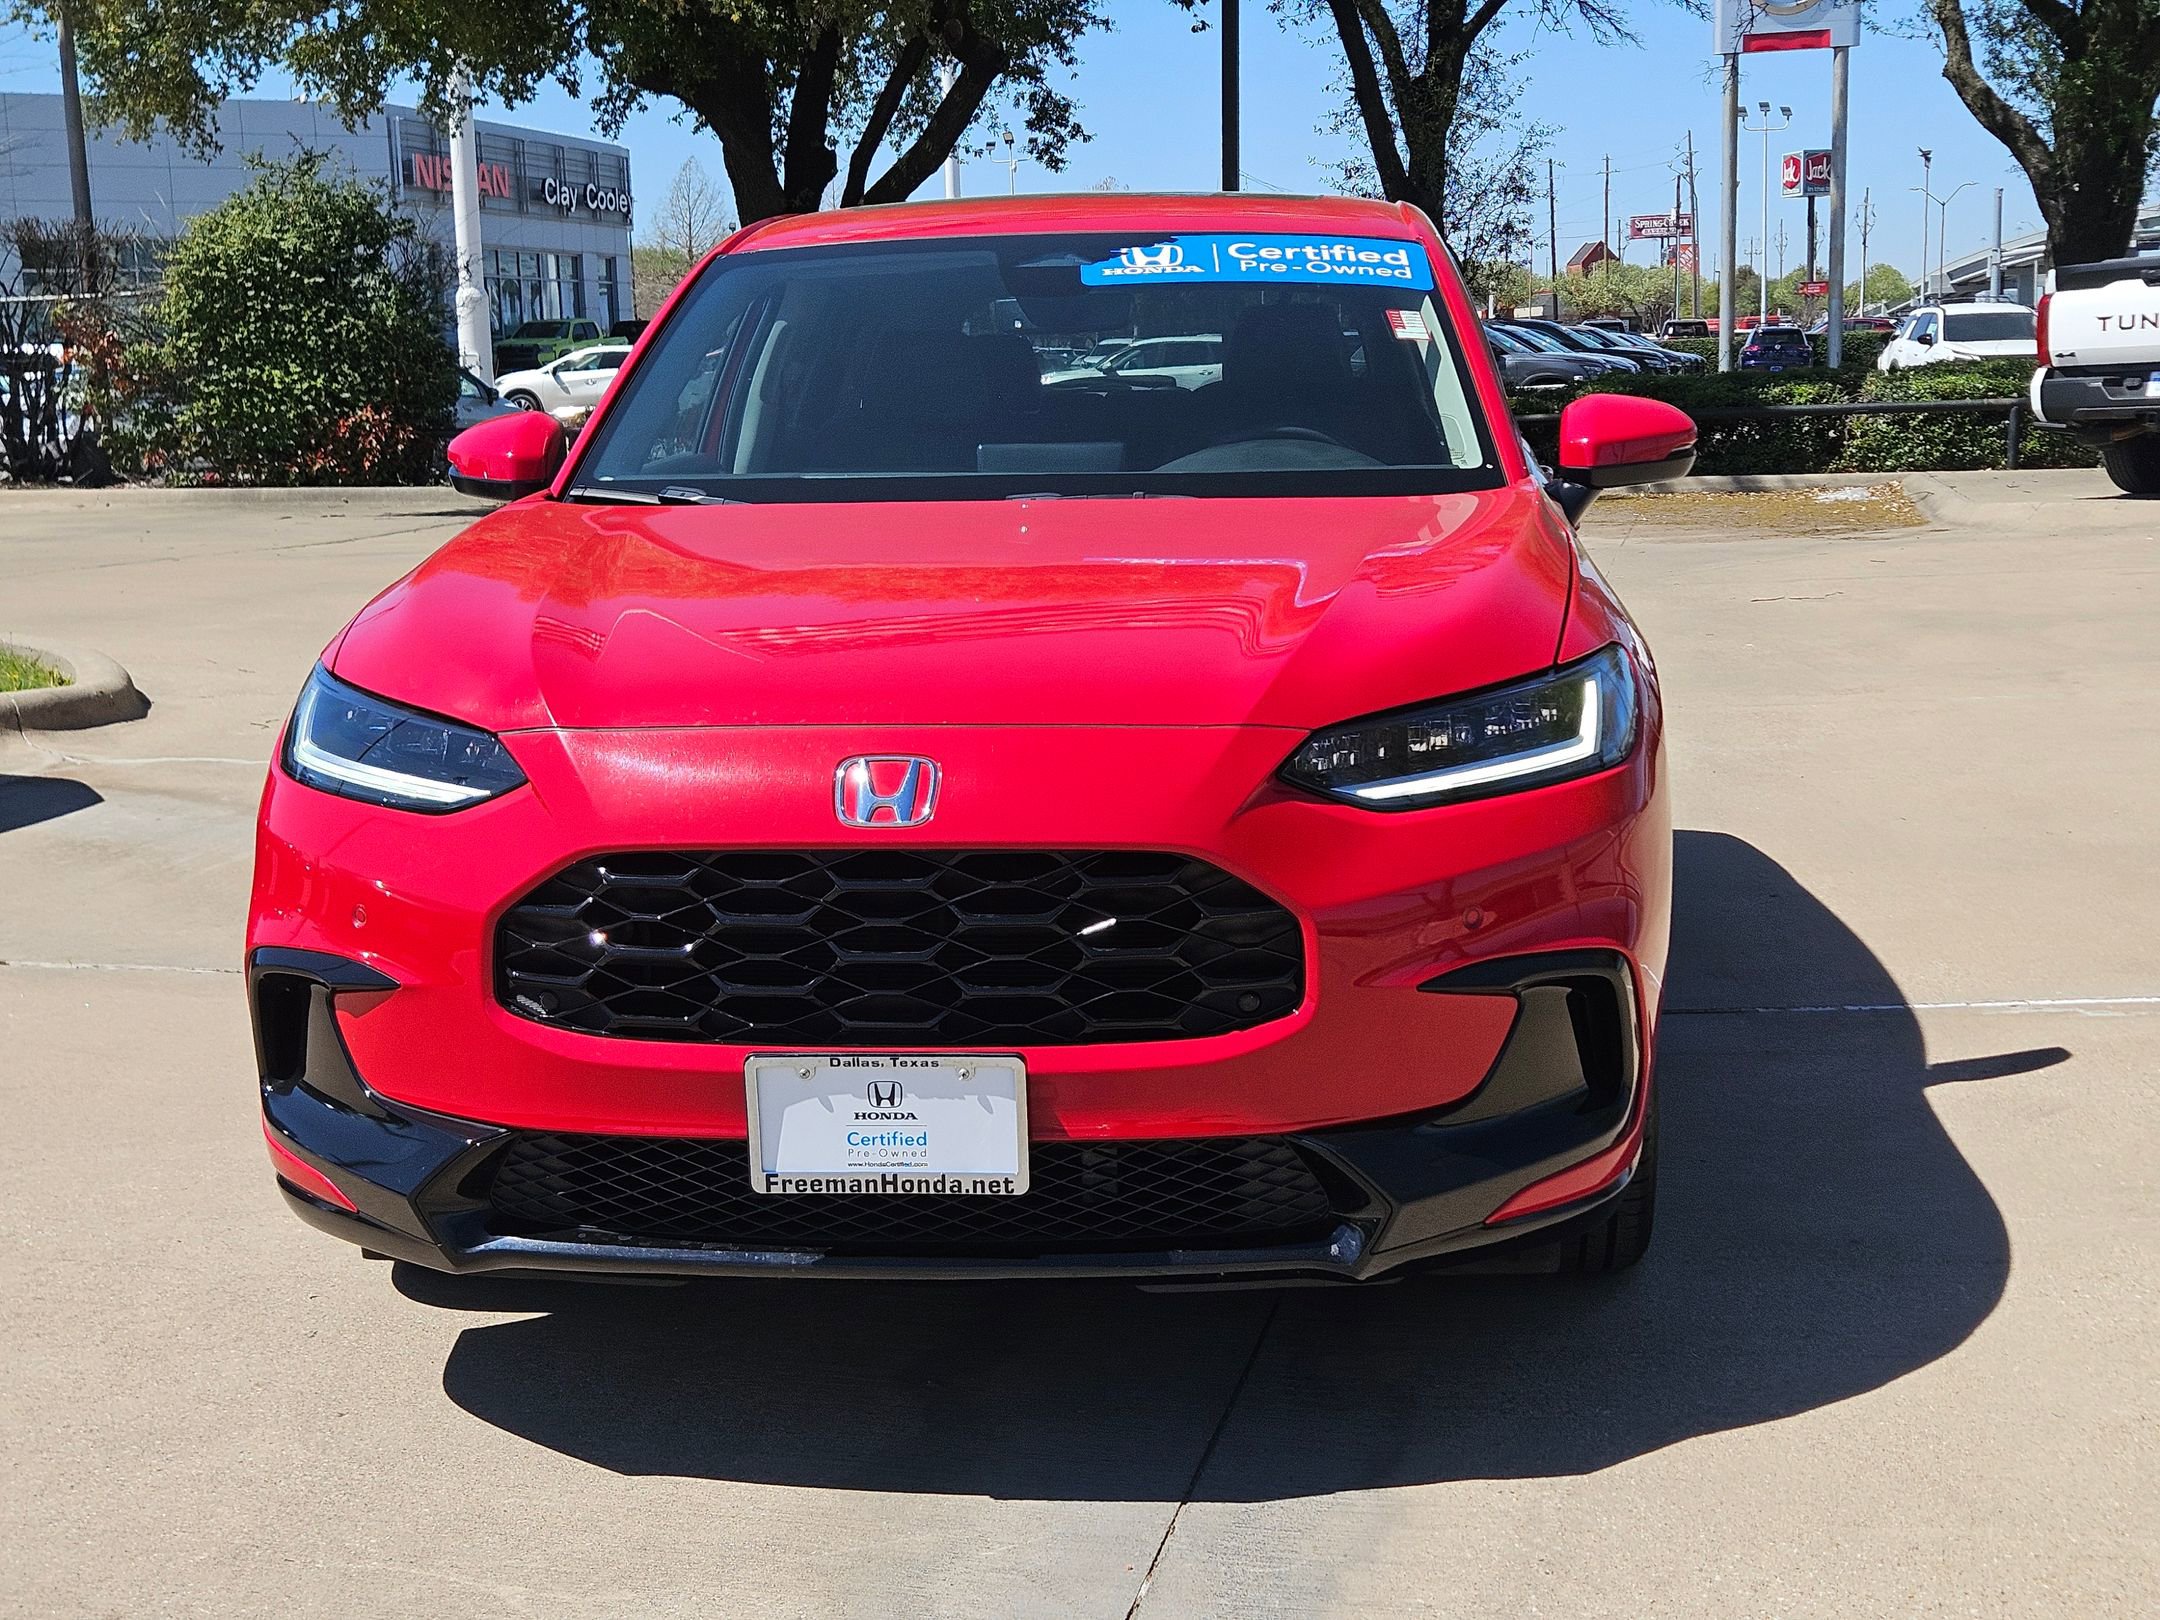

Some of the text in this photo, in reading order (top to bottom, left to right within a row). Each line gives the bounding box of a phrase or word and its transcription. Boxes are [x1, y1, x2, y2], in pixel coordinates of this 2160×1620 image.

[415, 152, 510, 198] NISAN
[1806, 156, 1831, 181] Jack
[545, 177, 633, 219] Clay Cooley
[1227, 242, 1410, 266] Certified
[1102, 265, 1205, 276] HONDA
[1240, 260, 1413, 280] Pre-Owned
[829, 1057, 940, 1068] Dallas, Texas
[853, 1112, 918, 1121] HONDA
[847, 1131, 928, 1147] Certified
[848, 1148, 927, 1158] Pre-Owned
[765, 1173, 1015, 1194] FreemanHonda.net
